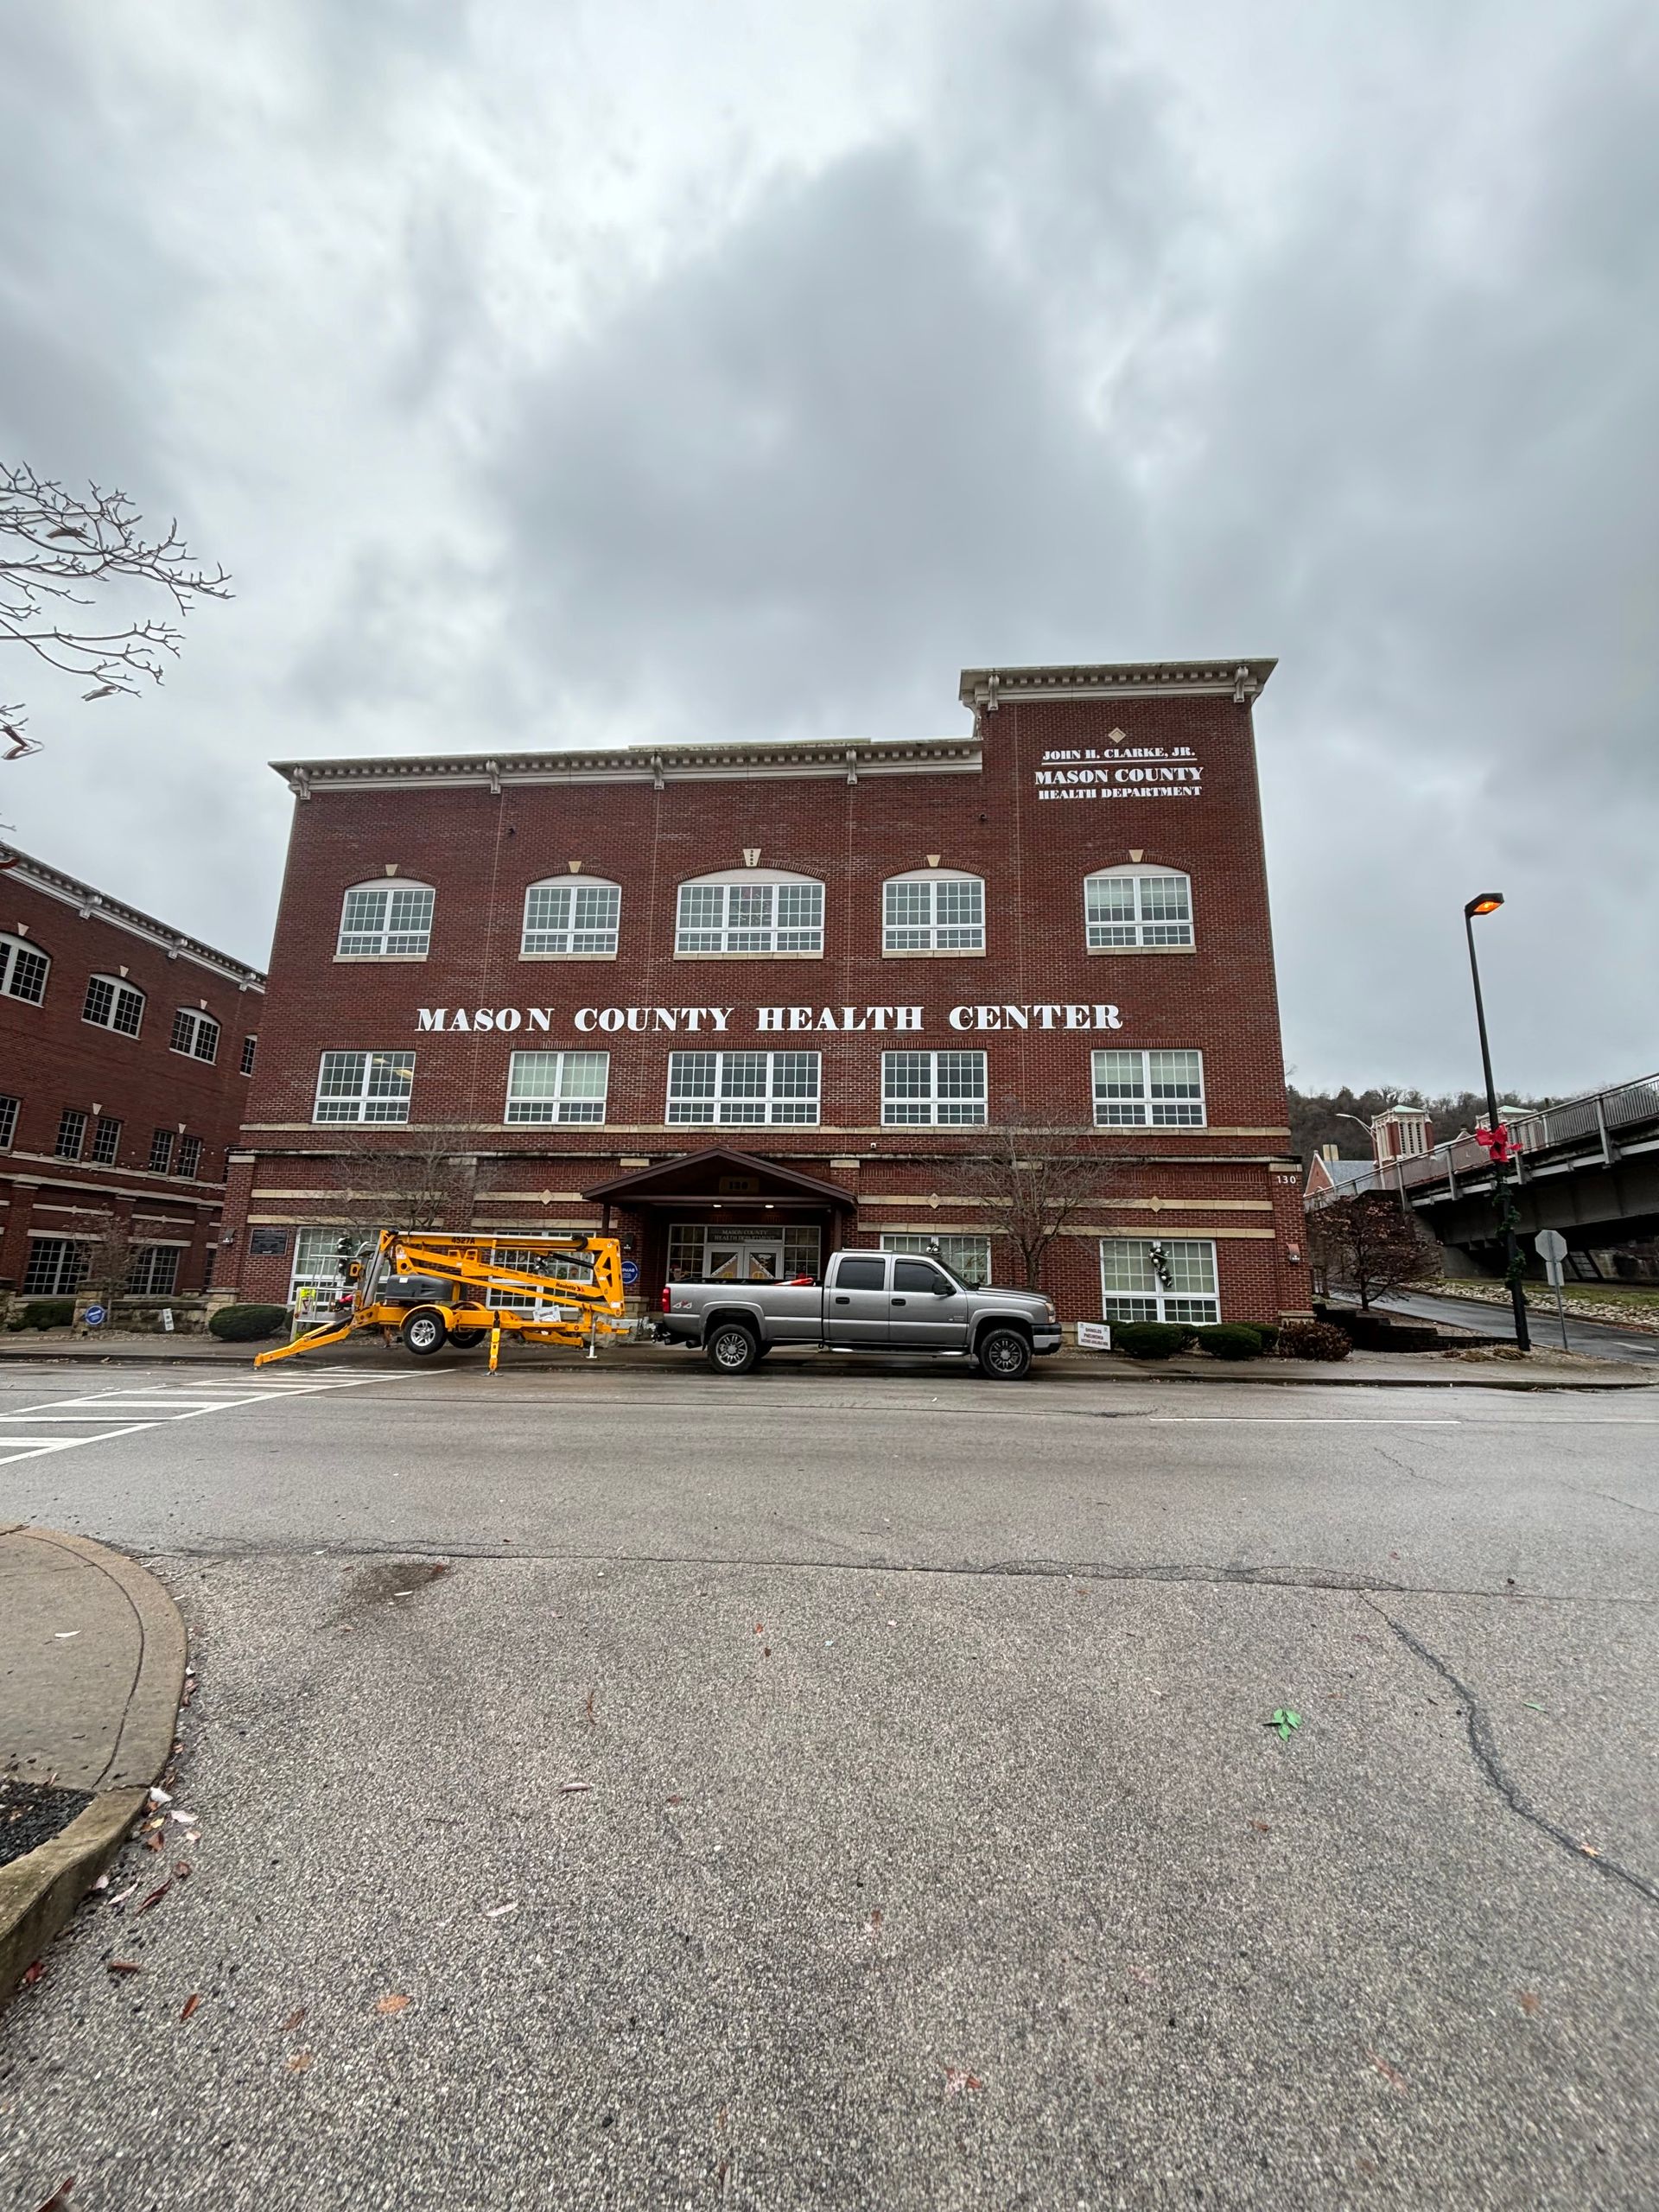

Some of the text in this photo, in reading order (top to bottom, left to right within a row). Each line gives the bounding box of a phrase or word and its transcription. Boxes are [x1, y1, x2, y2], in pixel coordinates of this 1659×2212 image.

[1043, 747, 1196, 760] JOHN H. CLARKE, JR.
[1034, 766, 1204, 785] MASON COUNTY
[1039, 786, 1202, 799] HEALTH DEPARTMENT
[414, 1005, 1123, 1032] MASON COUNTY HEALTH CENTER
[1277, 1175, 1296, 1184] 130
